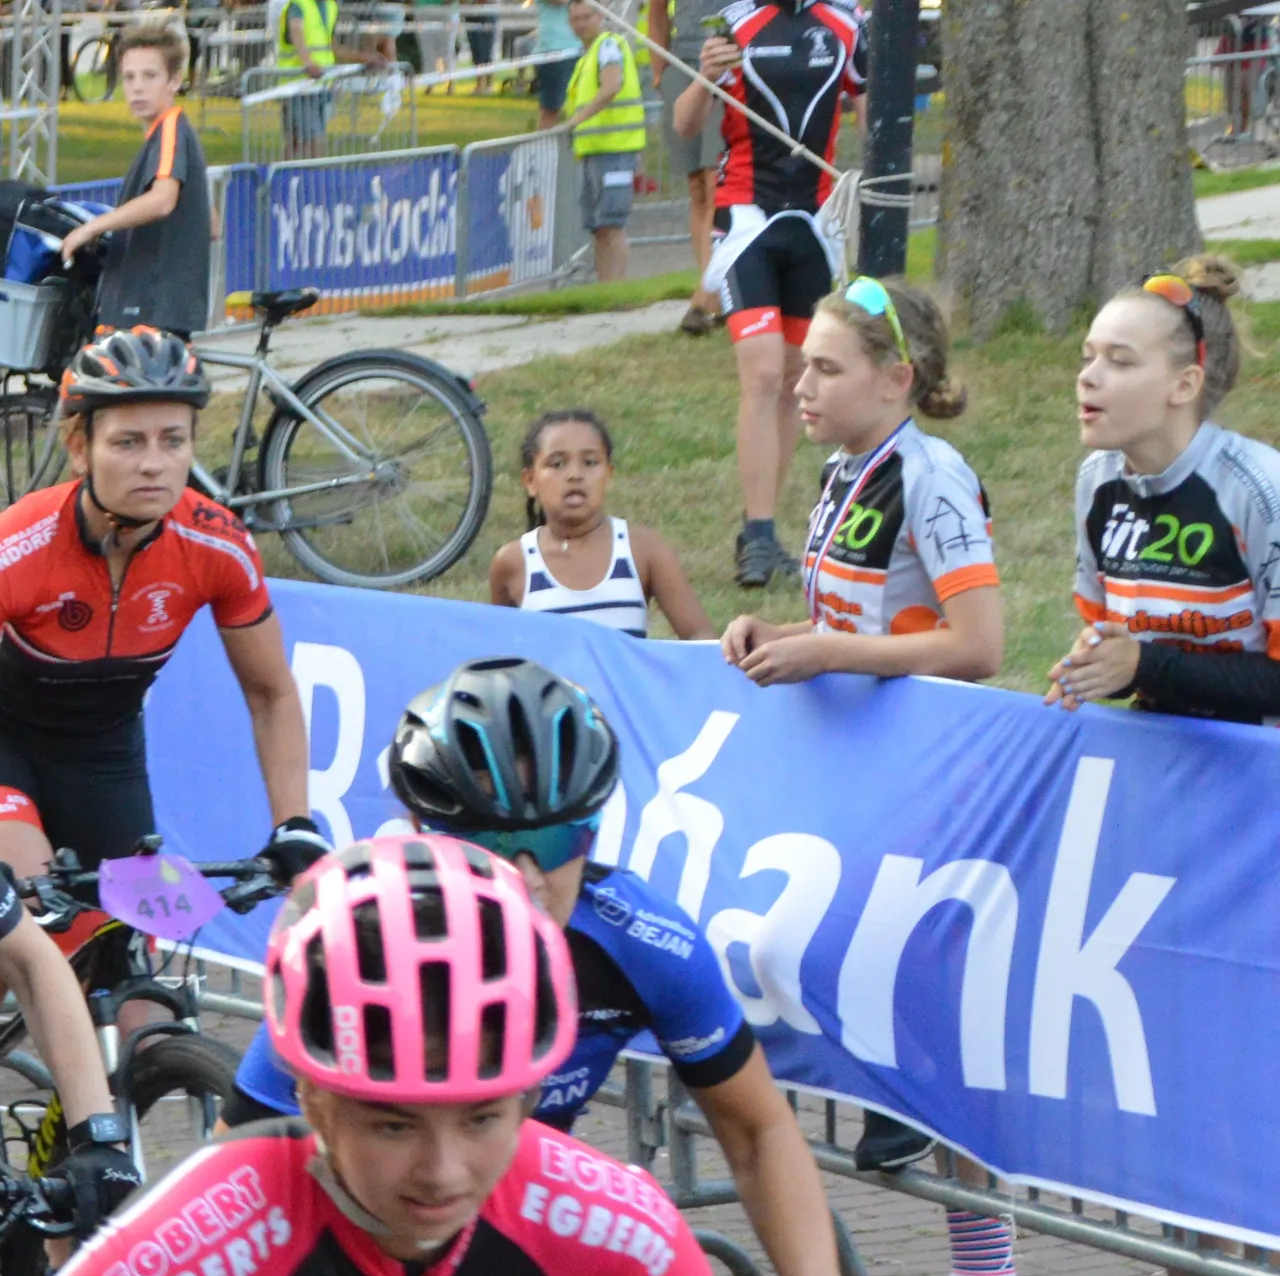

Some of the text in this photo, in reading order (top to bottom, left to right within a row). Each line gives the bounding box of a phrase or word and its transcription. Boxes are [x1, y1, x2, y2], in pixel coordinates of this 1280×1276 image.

[136, 893, 192, 919] 414
[626, 921, 695, 961] BEJAN
[333, 1004, 361, 1077] POC
